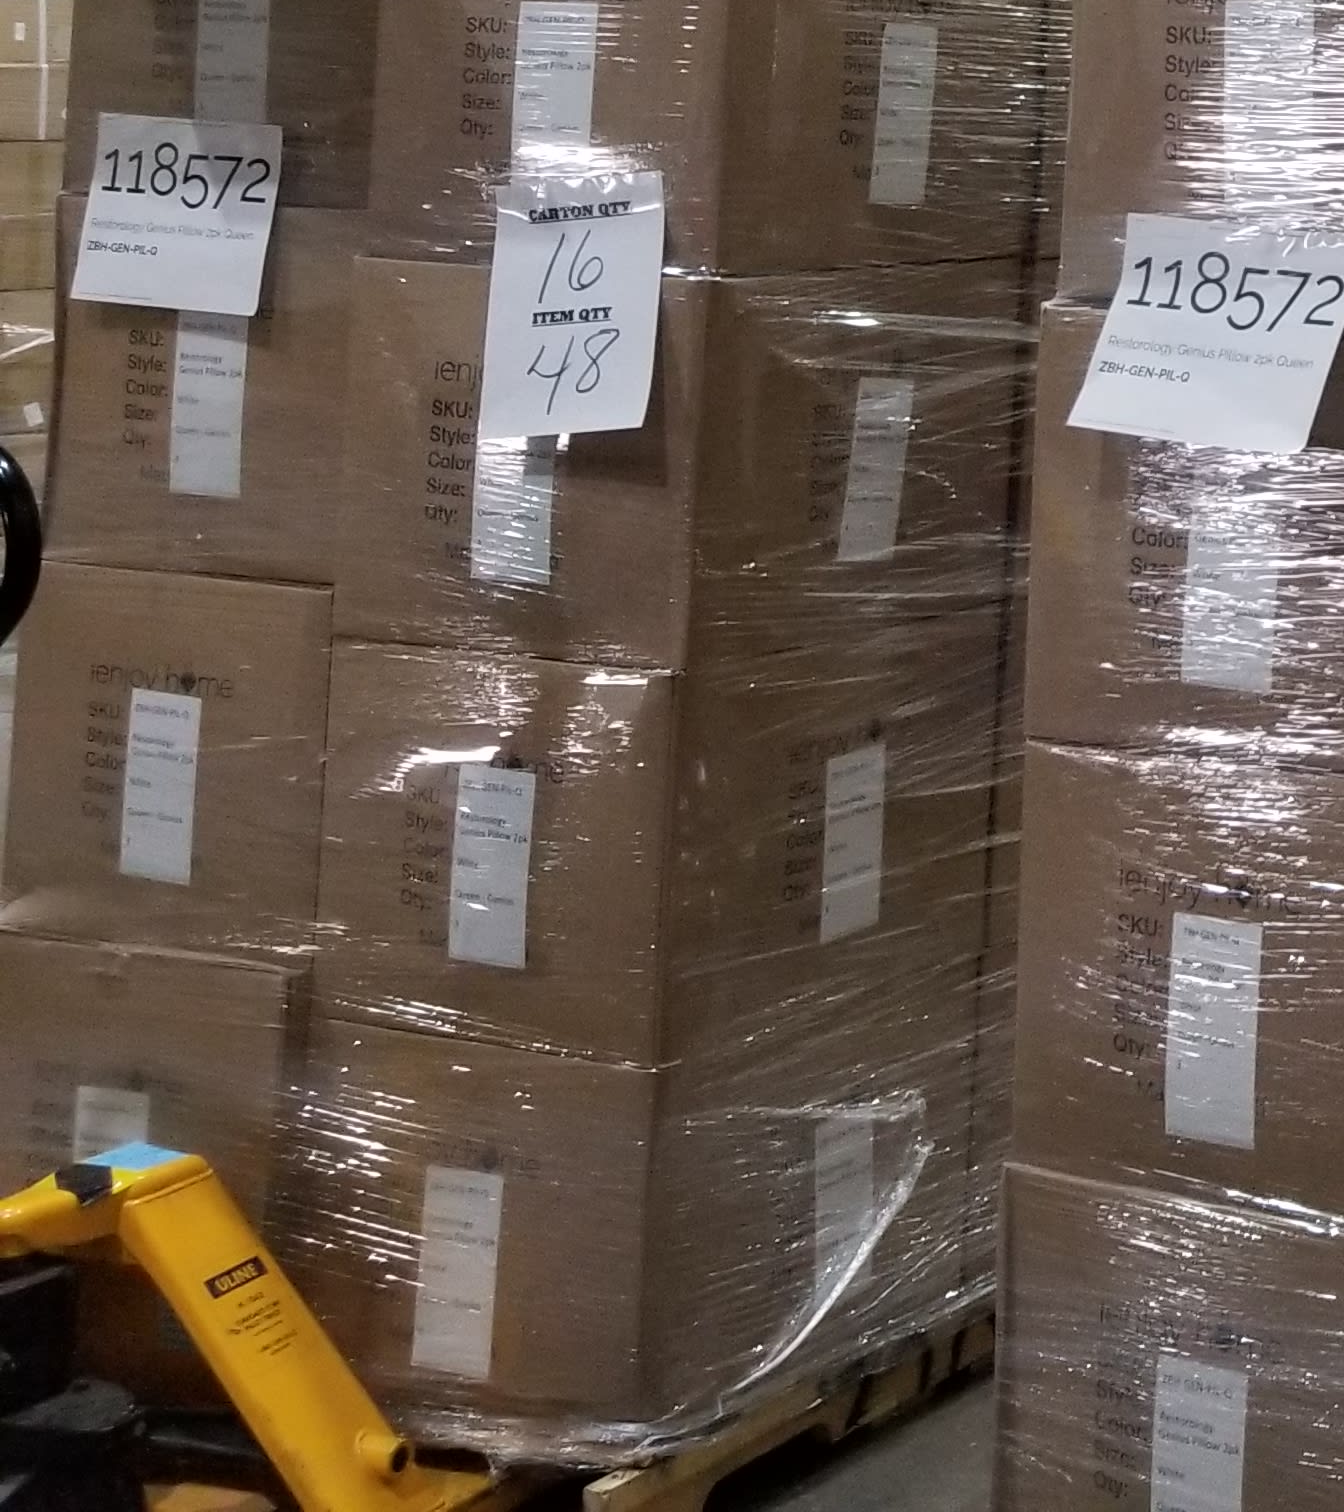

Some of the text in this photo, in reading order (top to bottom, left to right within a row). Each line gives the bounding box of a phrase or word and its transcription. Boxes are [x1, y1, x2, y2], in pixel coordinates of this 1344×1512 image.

[466, 17, 508, 33] SKU:
[1166, 26, 1212, 45] SKU:
[464, 42, 511, 63] Style:
[463, 68, 513, 86] Color:
[462, 94, 501, 110] Size:
[460, 119, 495, 139] Qty:
[101, 142, 270, 209] 118572
[528, 201, 632, 222] CARTON QTY
[538, 229, 604, 303] 16
[1127, 251, 1344, 332] 118572
[532, 306, 612, 324] ITEM QTY
[1108, 335, 1172, 355] Restorology
[1177, 344, 1216, 359] Genius
[1218, 349, 1251, 363] Pillow
[1276, 355, 1314, 369] Queen
[127, 354, 167, 374] Style:
[527, 329, 620, 415] 48
[1099, 361, 1190, 383] ZBH-GEN-PIL-Q
[126, 380, 168, 397] Color:
[431, 400, 473, 419] SKU:
[429, 425, 476, 446] Style:
[426, 480, 466, 498] Size:
[424, 504, 458, 526] Qty:
[1131, 527, 1189, 549] Color:
[214, 1263, 260, 1293] ULINE
